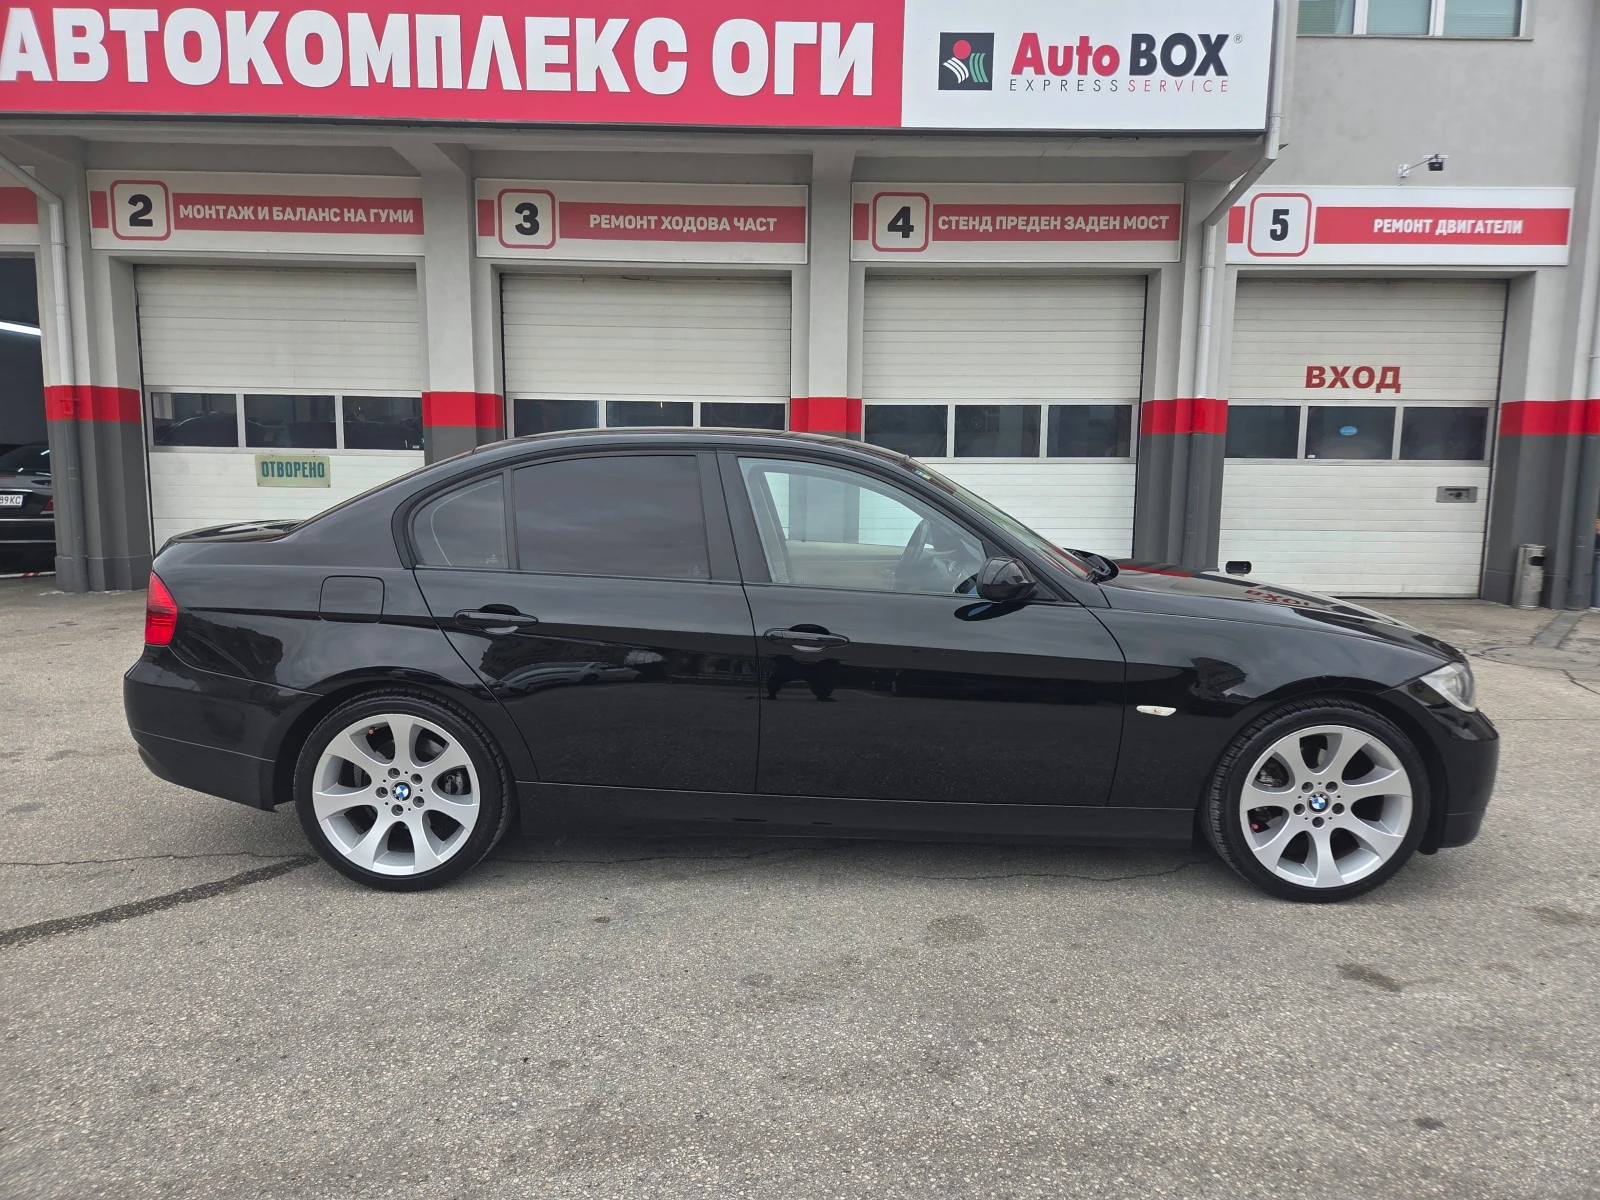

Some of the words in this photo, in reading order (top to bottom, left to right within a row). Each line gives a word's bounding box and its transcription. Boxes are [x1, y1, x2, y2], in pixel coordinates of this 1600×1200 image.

[0, 7, 688, 95] АВТОКОМПЛЕКС
[711, 18, 874, 97] ОГИ
[1010, 32, 1121, 77] Auto
[1128, 32, 1230, 77] BOX
[1009, 78, 1119, 92] EXPRESS
[1127, 79, 1229, 93] SERVICE
[127, 193, 154, 228] 2
[179, 204, 255, 220] МОНТАЖ
[257, 205, 270, 220] И
[272, 206, 341, 223] БАЛАНС
[344, 207, 368, 223] НА
[369, 208, 414, 223] ГУМИ
[514, 202, 540, 236] 3
[589, 214, 658, 230] РЕМОНТ
[660, 215, 731, 233] ХОДОВА
[733, 217, 778, 232] ЧАСТ
[887, 205, 915, 239] 4
[937, 215, 993, 232] СТЕНД
[995, 215, 1062, 233] ПРЕДЕН
[1064, 215, 1120, 233] ЗАДЕН
[1123, 215, 1170, 230] МОСТ
[1269, 208, 1290, 242] 5
[1373, 218, 1434, 233] РЕМОНТ
[1435, 219, 1524, 236] ДВИГАТЕЛИ
[1305, 365, 1402, 394] ВХОД
[260, 460, 326, 478] ОТВОРЕНО
